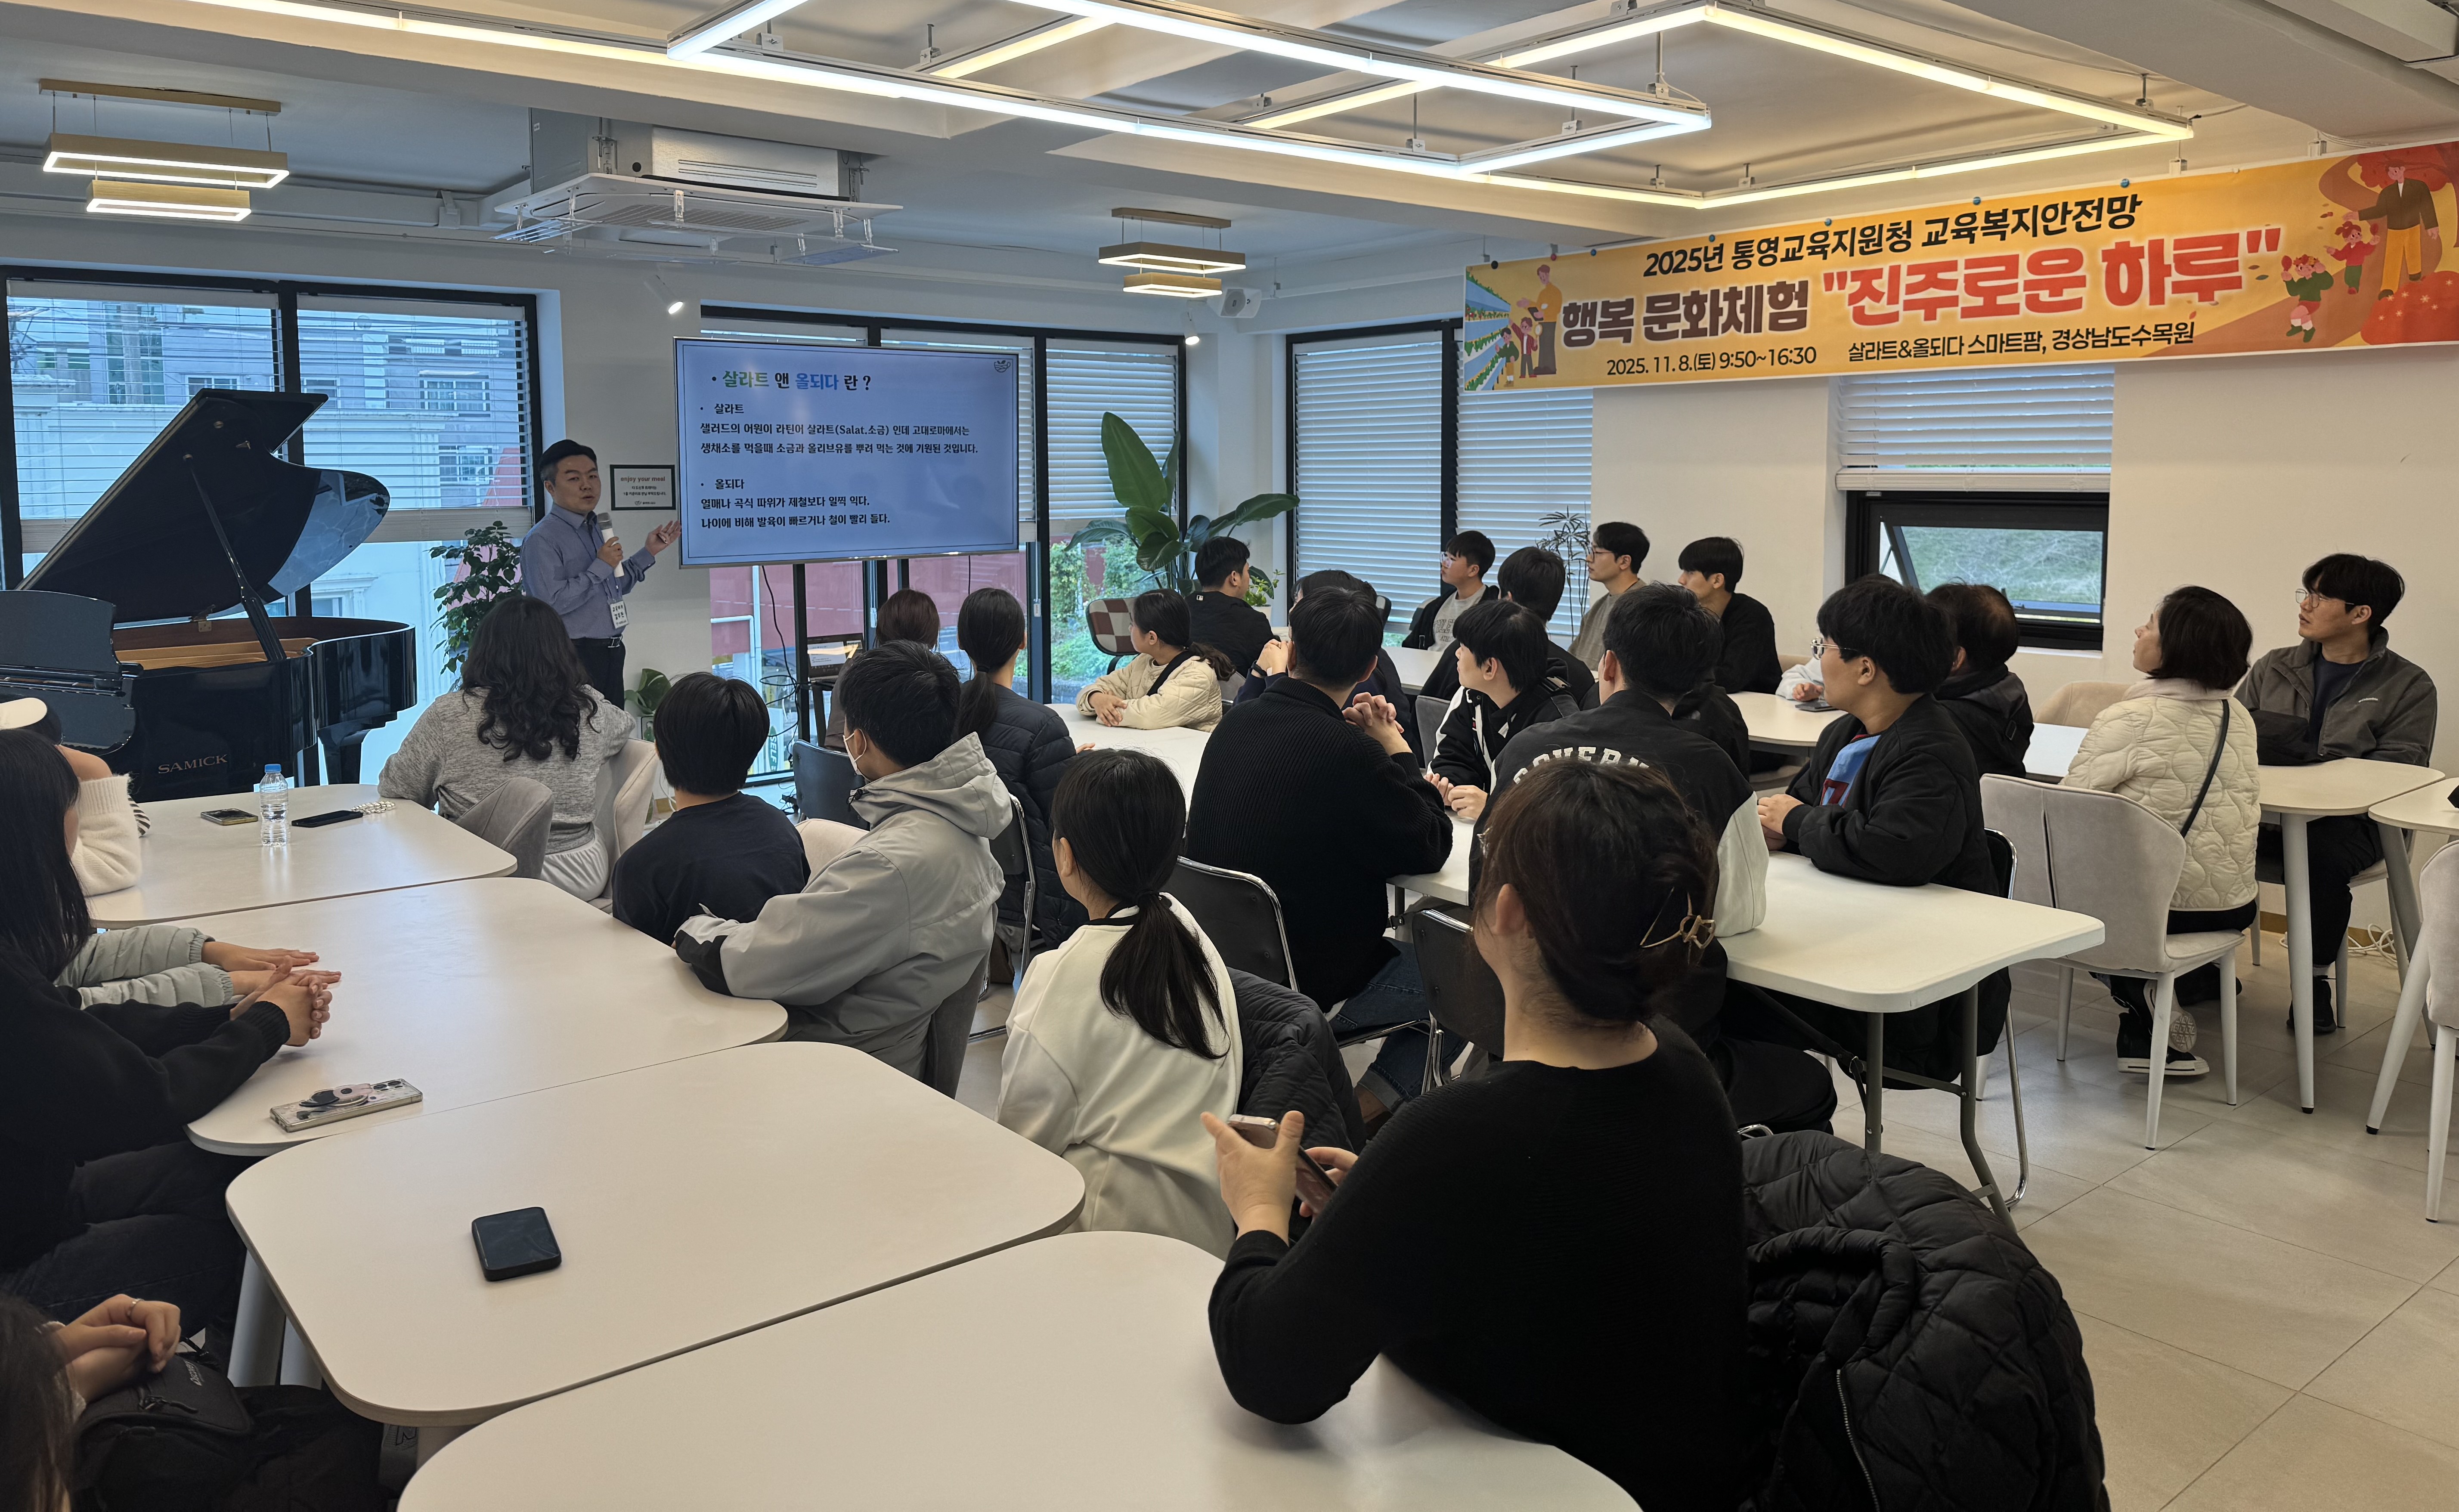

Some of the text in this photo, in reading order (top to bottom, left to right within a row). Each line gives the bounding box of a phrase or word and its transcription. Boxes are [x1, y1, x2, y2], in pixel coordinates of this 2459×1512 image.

[1643, 194, 2143, 277] 2025년 통영교육지원청 교육복지안전망
[1562, 227, 2282, 347] 행복 문화체험 "진주로운 하루"
[1848, 322, 2194, 363] 살라트&올되다 스마트팜, 경상남도수목원
[1607, 346, 1816, 375] 2025. 11. 8.(토) 9:50~16:30
[723, 371, 870, 390] 살라트 앤 올되다 란 ?
[715, 404, 744, 414] 살라트
[700, 423, 740, 433] 샐러드의
[744, 424, 772, 434] 어원이
[776, 424, 803, 434] 라틴어
[893, 426, 909, 435] 인데
[913, 426, 969, 436] 고대로마에서는
[701, 443, 978, 453] 생채소를 먹을때 소금과 올리브유를 뿌려 먹는 것에 기원된 것입니다.
[715, 479, 744, 489] 올되다
[701, 496, 869, 509] 열매나 곡식 따위가 제철보다 일찍 익다.
[701, 514, 889, 529] 나이에 비해 발육이 빠르거나 철이 빨리 들다.
[158, 754, 227, 774] SAMICK
